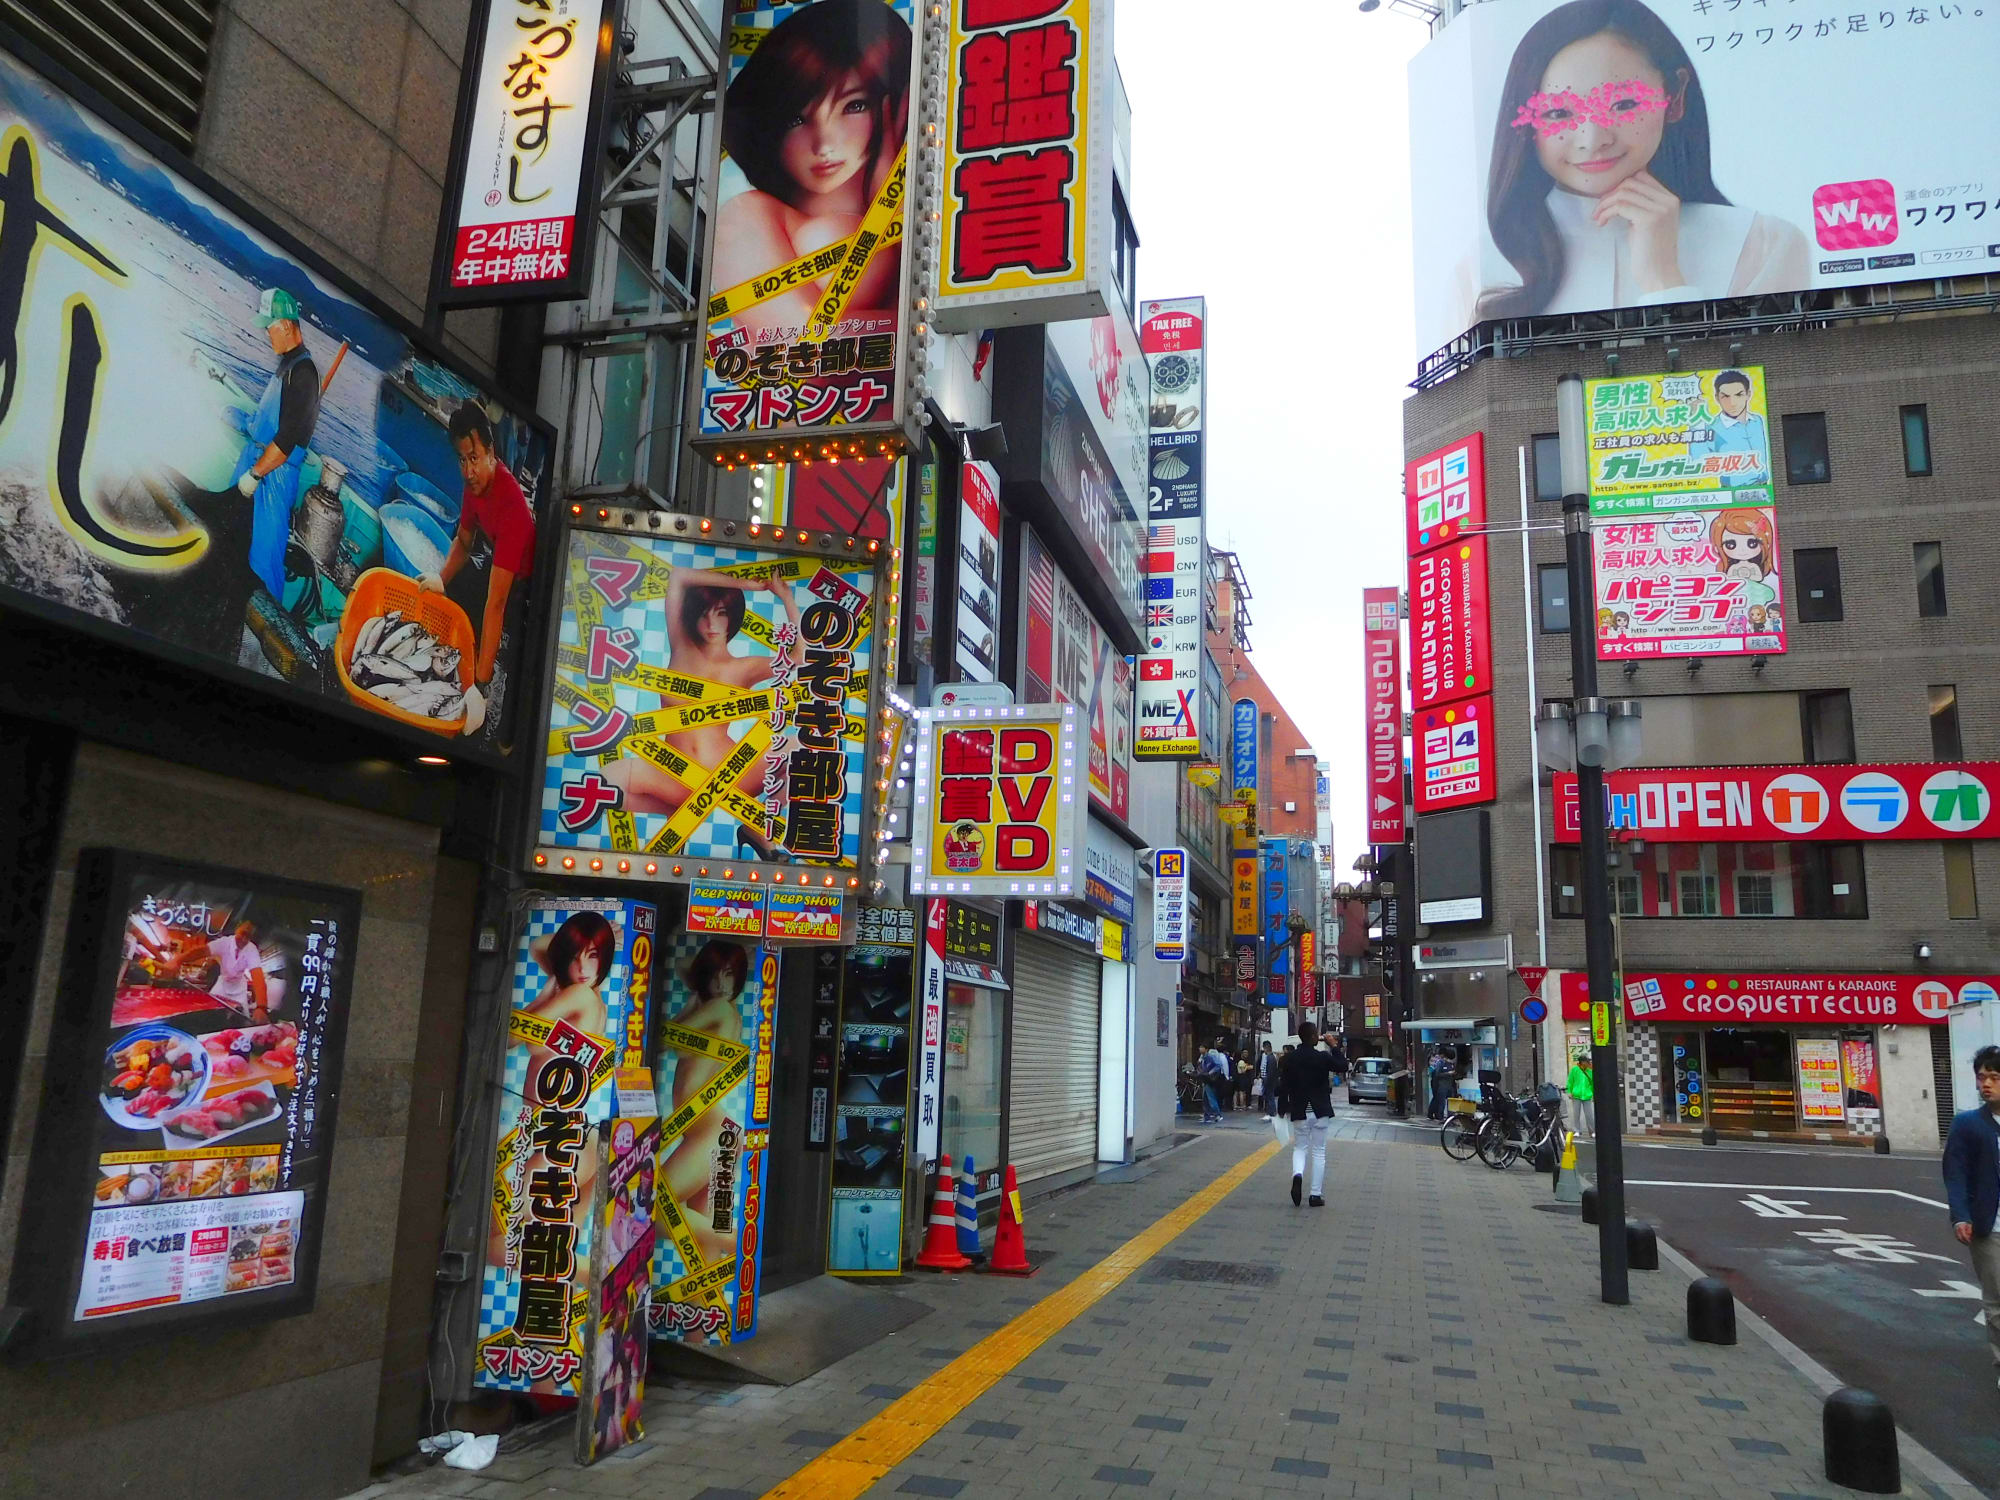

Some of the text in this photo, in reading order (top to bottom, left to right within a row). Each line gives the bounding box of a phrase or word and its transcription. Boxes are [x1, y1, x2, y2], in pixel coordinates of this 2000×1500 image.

[1696, 3, 1985, 52] ワクワクが足りない。
[952, 0, 1078, 282] 鑑賞
[466, 220, 565, 253] 24時間
[457, 252, 567, 285] 年中無休
[756, 318, 893, 343] 素人ストリップショー
[1151, 317, 1193, 331] TAX FREE
[713, 329, 748, 352] 元祖
[715, 333, 895, 381] のぞき部屋
[711, 378, 888, 430] マドンナ
[1593, 382, 1650, 408] 男性
[1593, 404, 1714, 431] 高収入求人
[1150, 434, 1198, 446] HELLBIRD
[1601, 452, 1761, 481] ガンガン高収入
[1655, 496, 1720, 506] ガンガン高収入
[1079, 469, 1145, 618] SHELLBIRD
[1177, 536, 1198, 546] USD
[1603, 524, 1656, 546] 女性
[1176, 561, 1198, 571] CNY
[1602, 546, 1719, 570] 高収入求人
[814, 577, 862, 614] 元祖
[1175, 588, 1197, 598] EUR
[1461, 562, 1471, 621] RESTAURANT
[1603, 576, 1743, 601] パピヨン
[1175, 615, 1197, 625] GBP
[1439, 556, 1455, 690] CROQUETTECLUB
[1633, 596, 1743, 624] ジョブ
[1175, 642, 1197, 652] KRW
[1463, 628, 1474, 671] KARAOKE
[1174, 669, 1197, 679] HKD
[559, 554, 645, 832] マドンナ
[1141, 689, 1197, 735] MEX
[761, 621, 799, 842] 素人ストリップショー
[784, 600, 858, 858] のぞき部屋
[1143, 726, 1188, 738] 外貨両替
[1235, 704, 1256, 775] カラオケ
[1425, 729, 1477, 754] 24
[1137, 743, 1197, 753] Money EXchange
[940, 729, 994, 824] 鑑賞
[1235, 776, 1255, 789] 747
[1428, 760, 1477, 778] HOUR
[995, 727, 1053, 872] DVD
[1428, 779, 1478, 798] OPEN
[1638, 781, 1753, 829] OPEN
[1372, 819, 1401, 831] ENT
[948, 856, 979, 868] 金太郎
[725, 890, 762, 902] SHOW
[803, 895, 840, 907] SHOW
[141, 893, 234, 936] きづなすし
[634, 909, 654, 930] 元祖
[1065, 911, 1096, 943] SHELLBIRD
[1302, 932, 1313, 971] カラオケ
[1522, 971, 1543, 980] 止まれ
[1746, 979, 1897, 992] RESTAURANT & KARAOKE
[1682, 993, 1897, 1019] CROQUETTECLUB
[552, 1028, 598, 1069] 元祖
[754, 955, 777, 1123] のぞき部屋
[922, 967, 940, 1127] 最強買取
[711, 1129, 739, 1235] のぞき部屋
[511, 1054, 592, 1343] のぞき部屋
[93, 1231, 187, 1262] 寿司食べ放題
[736, 1150, 760, 1331] 1500円
[648, 1302, 727, 1334] マドンナ
[483, 1345, 581, 1383] マドンナ
